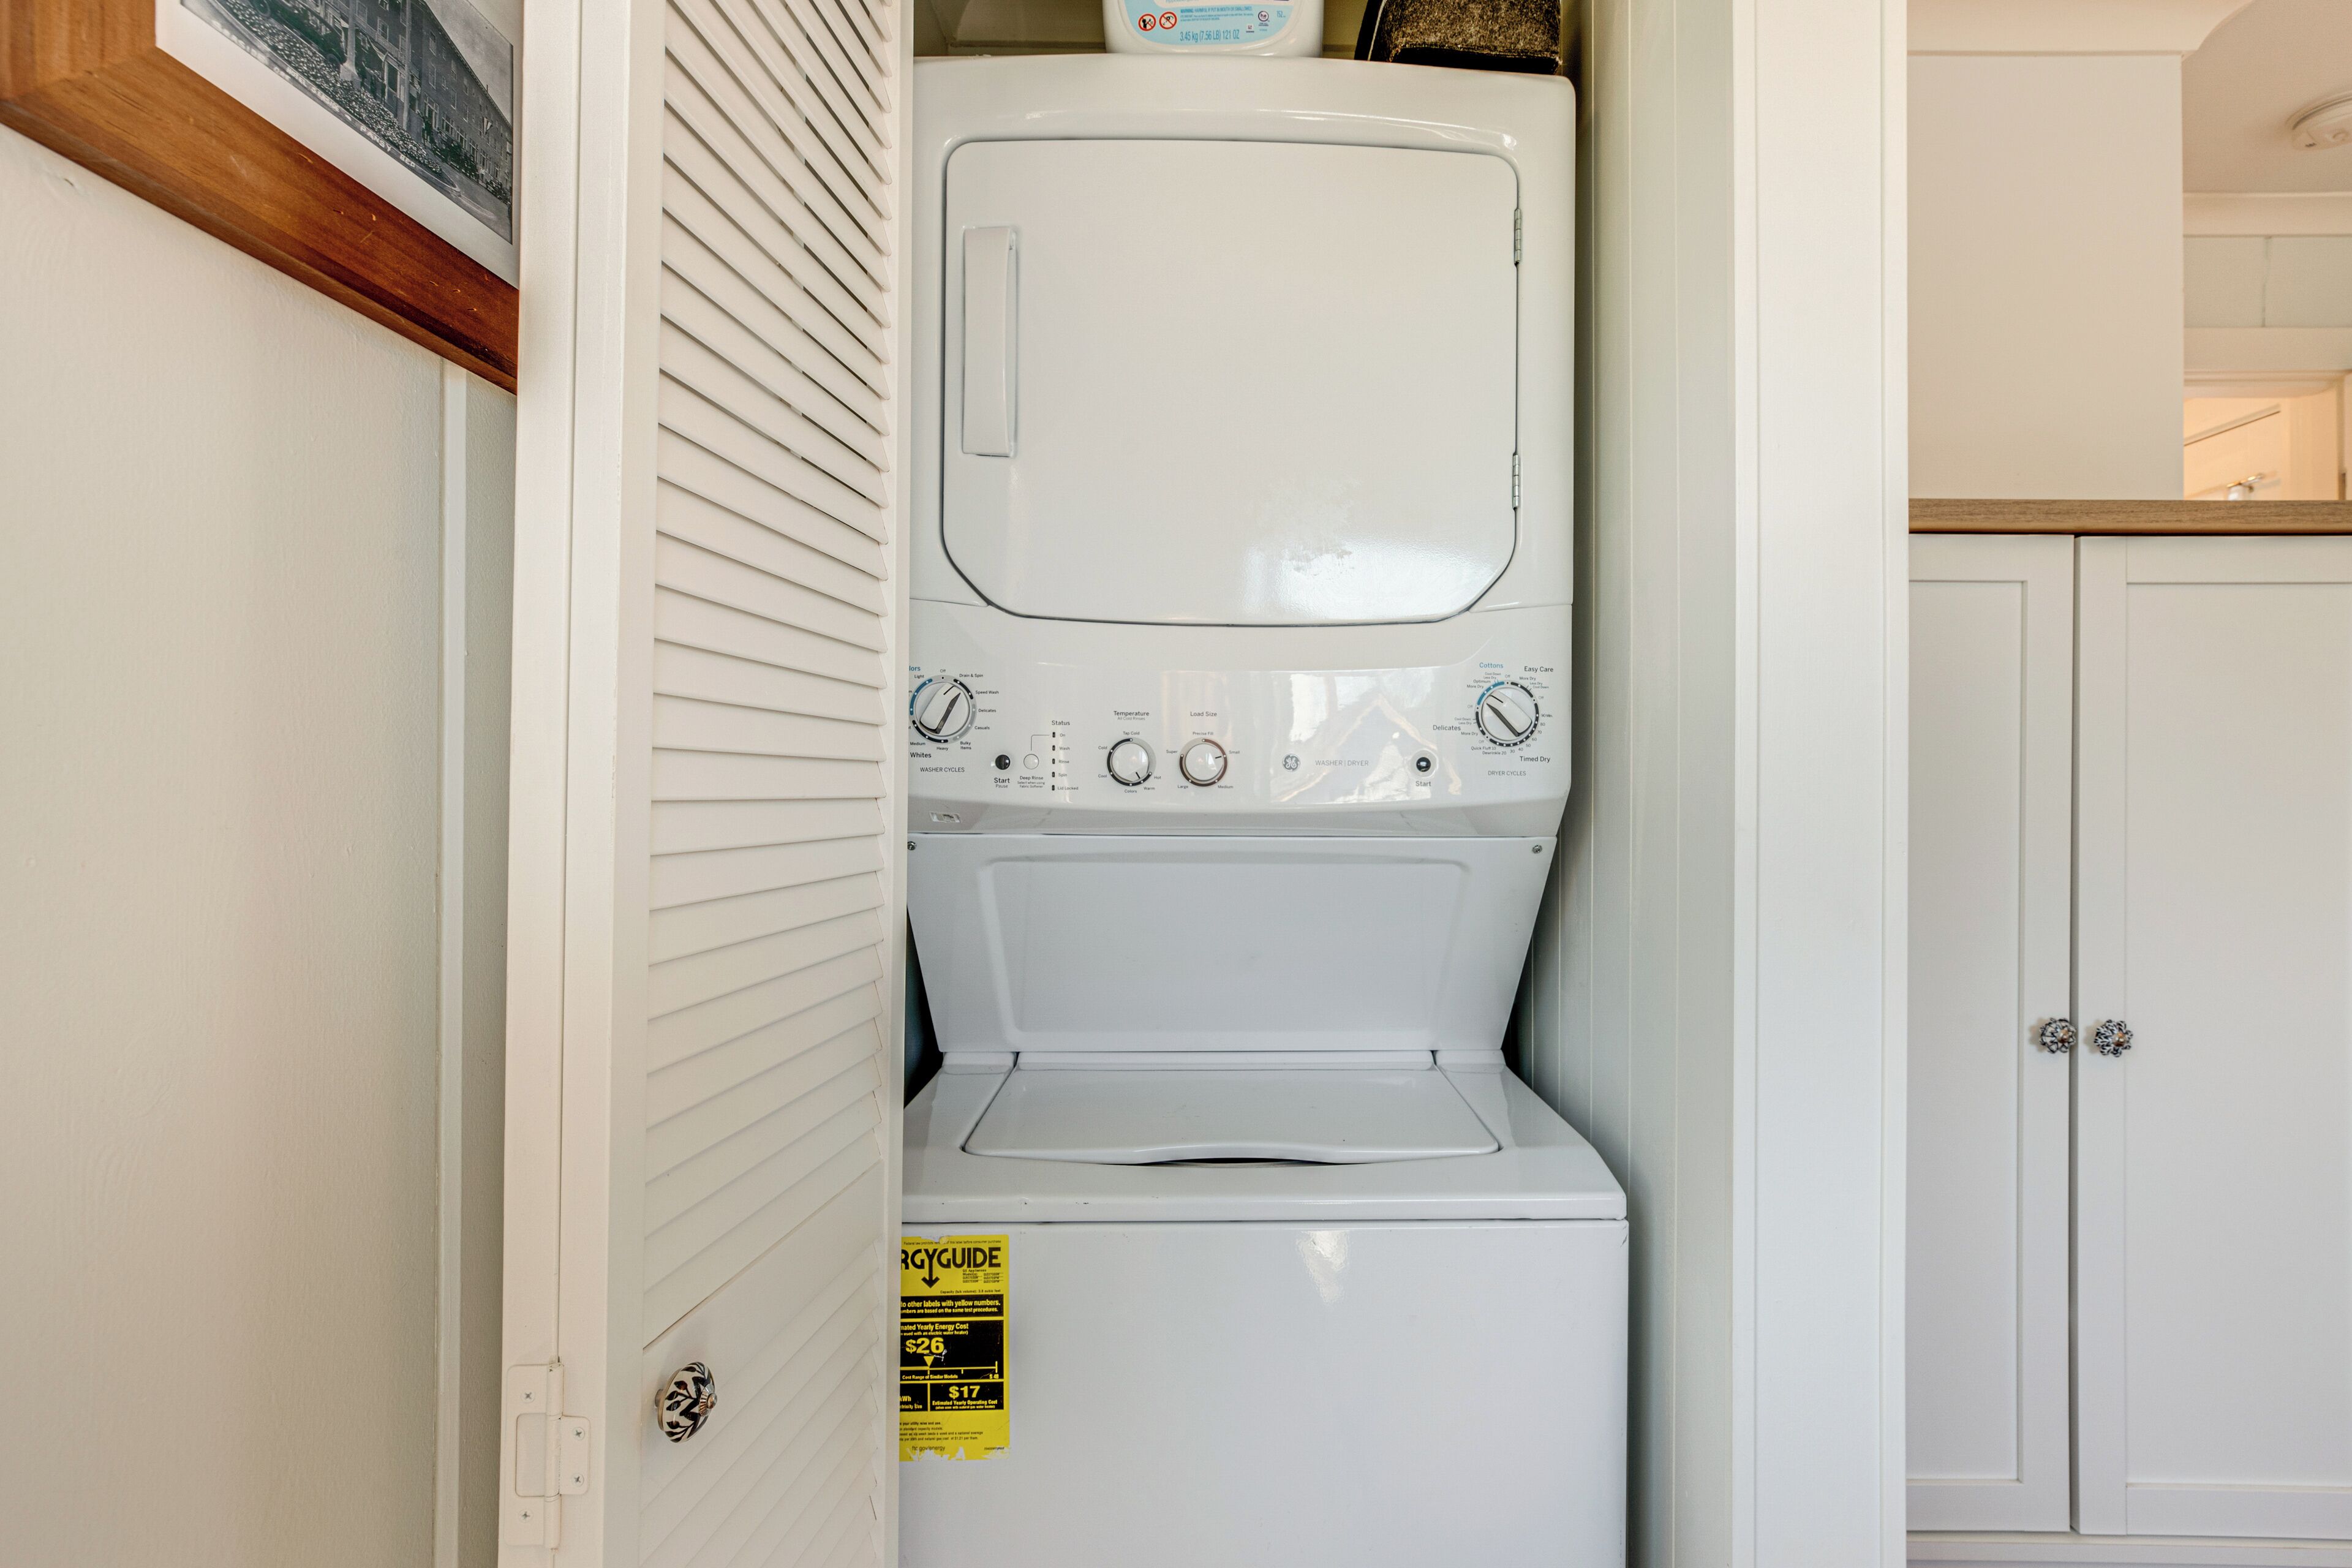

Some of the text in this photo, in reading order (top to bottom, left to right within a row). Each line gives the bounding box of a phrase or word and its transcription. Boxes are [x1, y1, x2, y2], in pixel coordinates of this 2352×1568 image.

[1180, 31, 1191, 41] 3.45
[1192, 31, 1198, 43] kg
[1199, 30, 1212, 42] (7.56
[1223, 29, 1231, 40] 121
[1232, 29, 1240, 39] OZ
[360, 126, 416, 168] PANSY BED
[954, 1299, 973, 1308] yellow
[917, 1323, 933, 1332] Yearly
[905, 1337, 944, 1354] $26
[949, 1385, 980, 1400] $17
